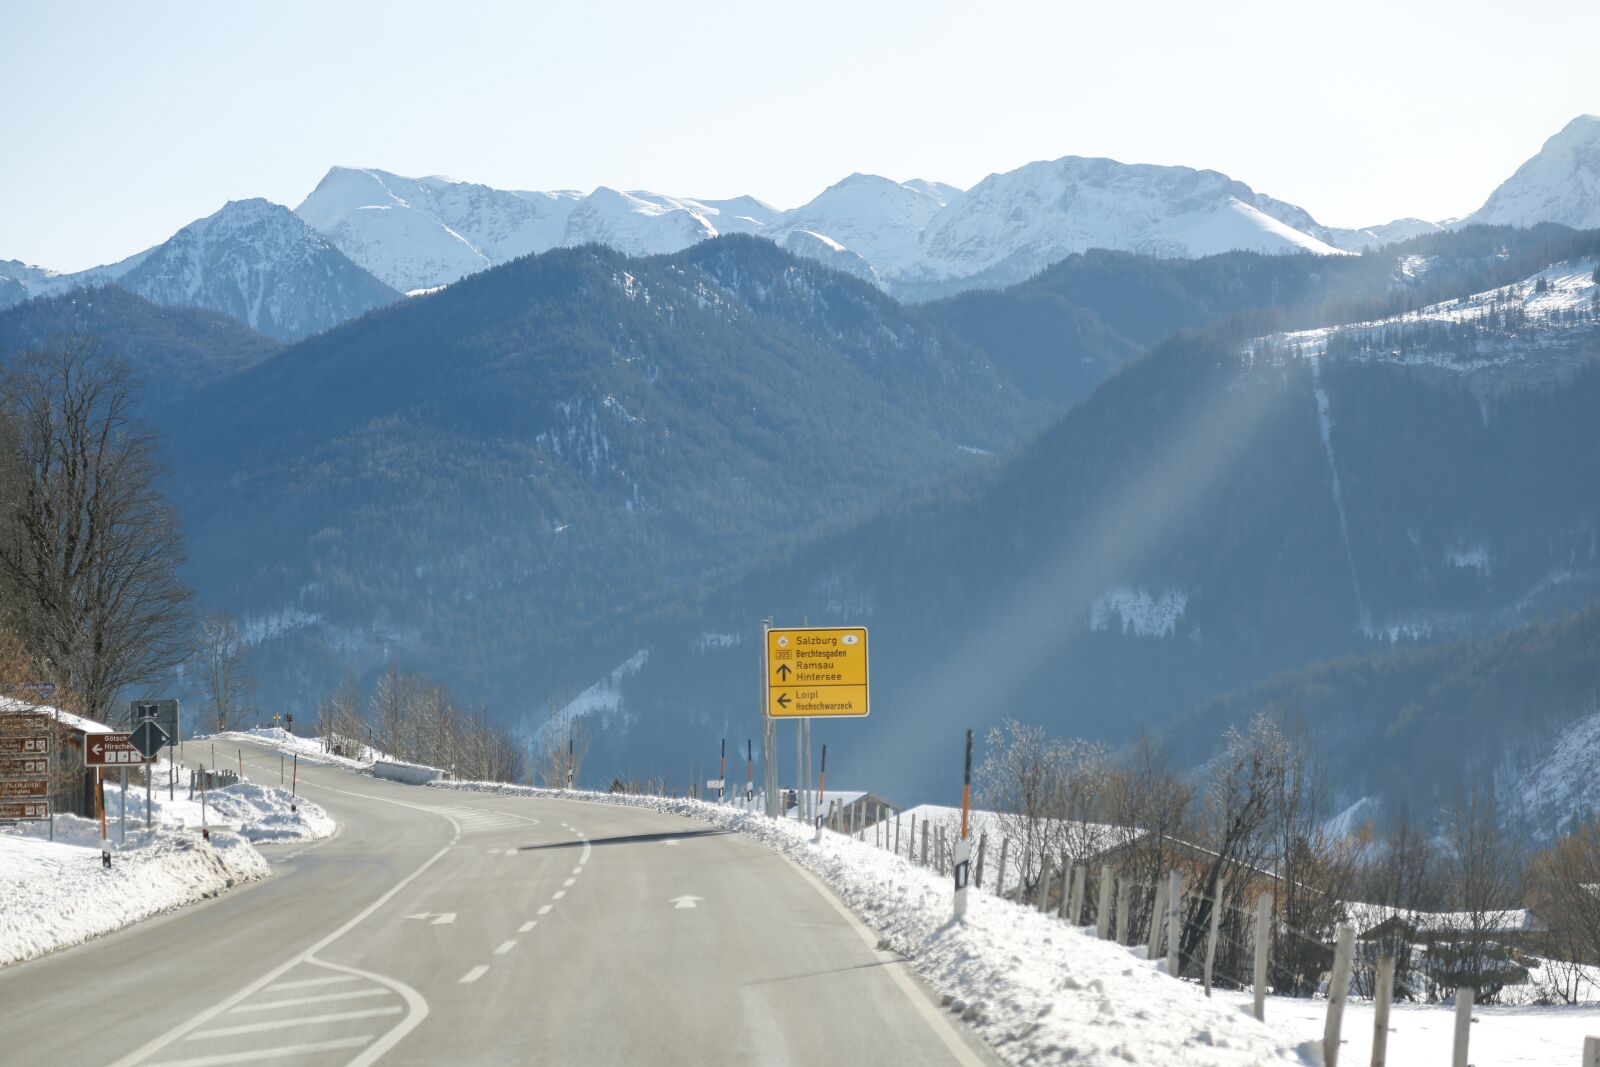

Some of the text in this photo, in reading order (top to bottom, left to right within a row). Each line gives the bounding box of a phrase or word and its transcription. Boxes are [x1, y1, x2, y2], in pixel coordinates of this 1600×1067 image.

[796, 636, 837, 646] Salzburg
[796, 650, 847, 659] Berchtesgaden
[796, 662, 834, 670] Ramsau
[796, 673, 842, 681] Hintersee
[796, 691, 818, 700] Loipl
[796, 701, 853, 711] Hochschwarzeck
